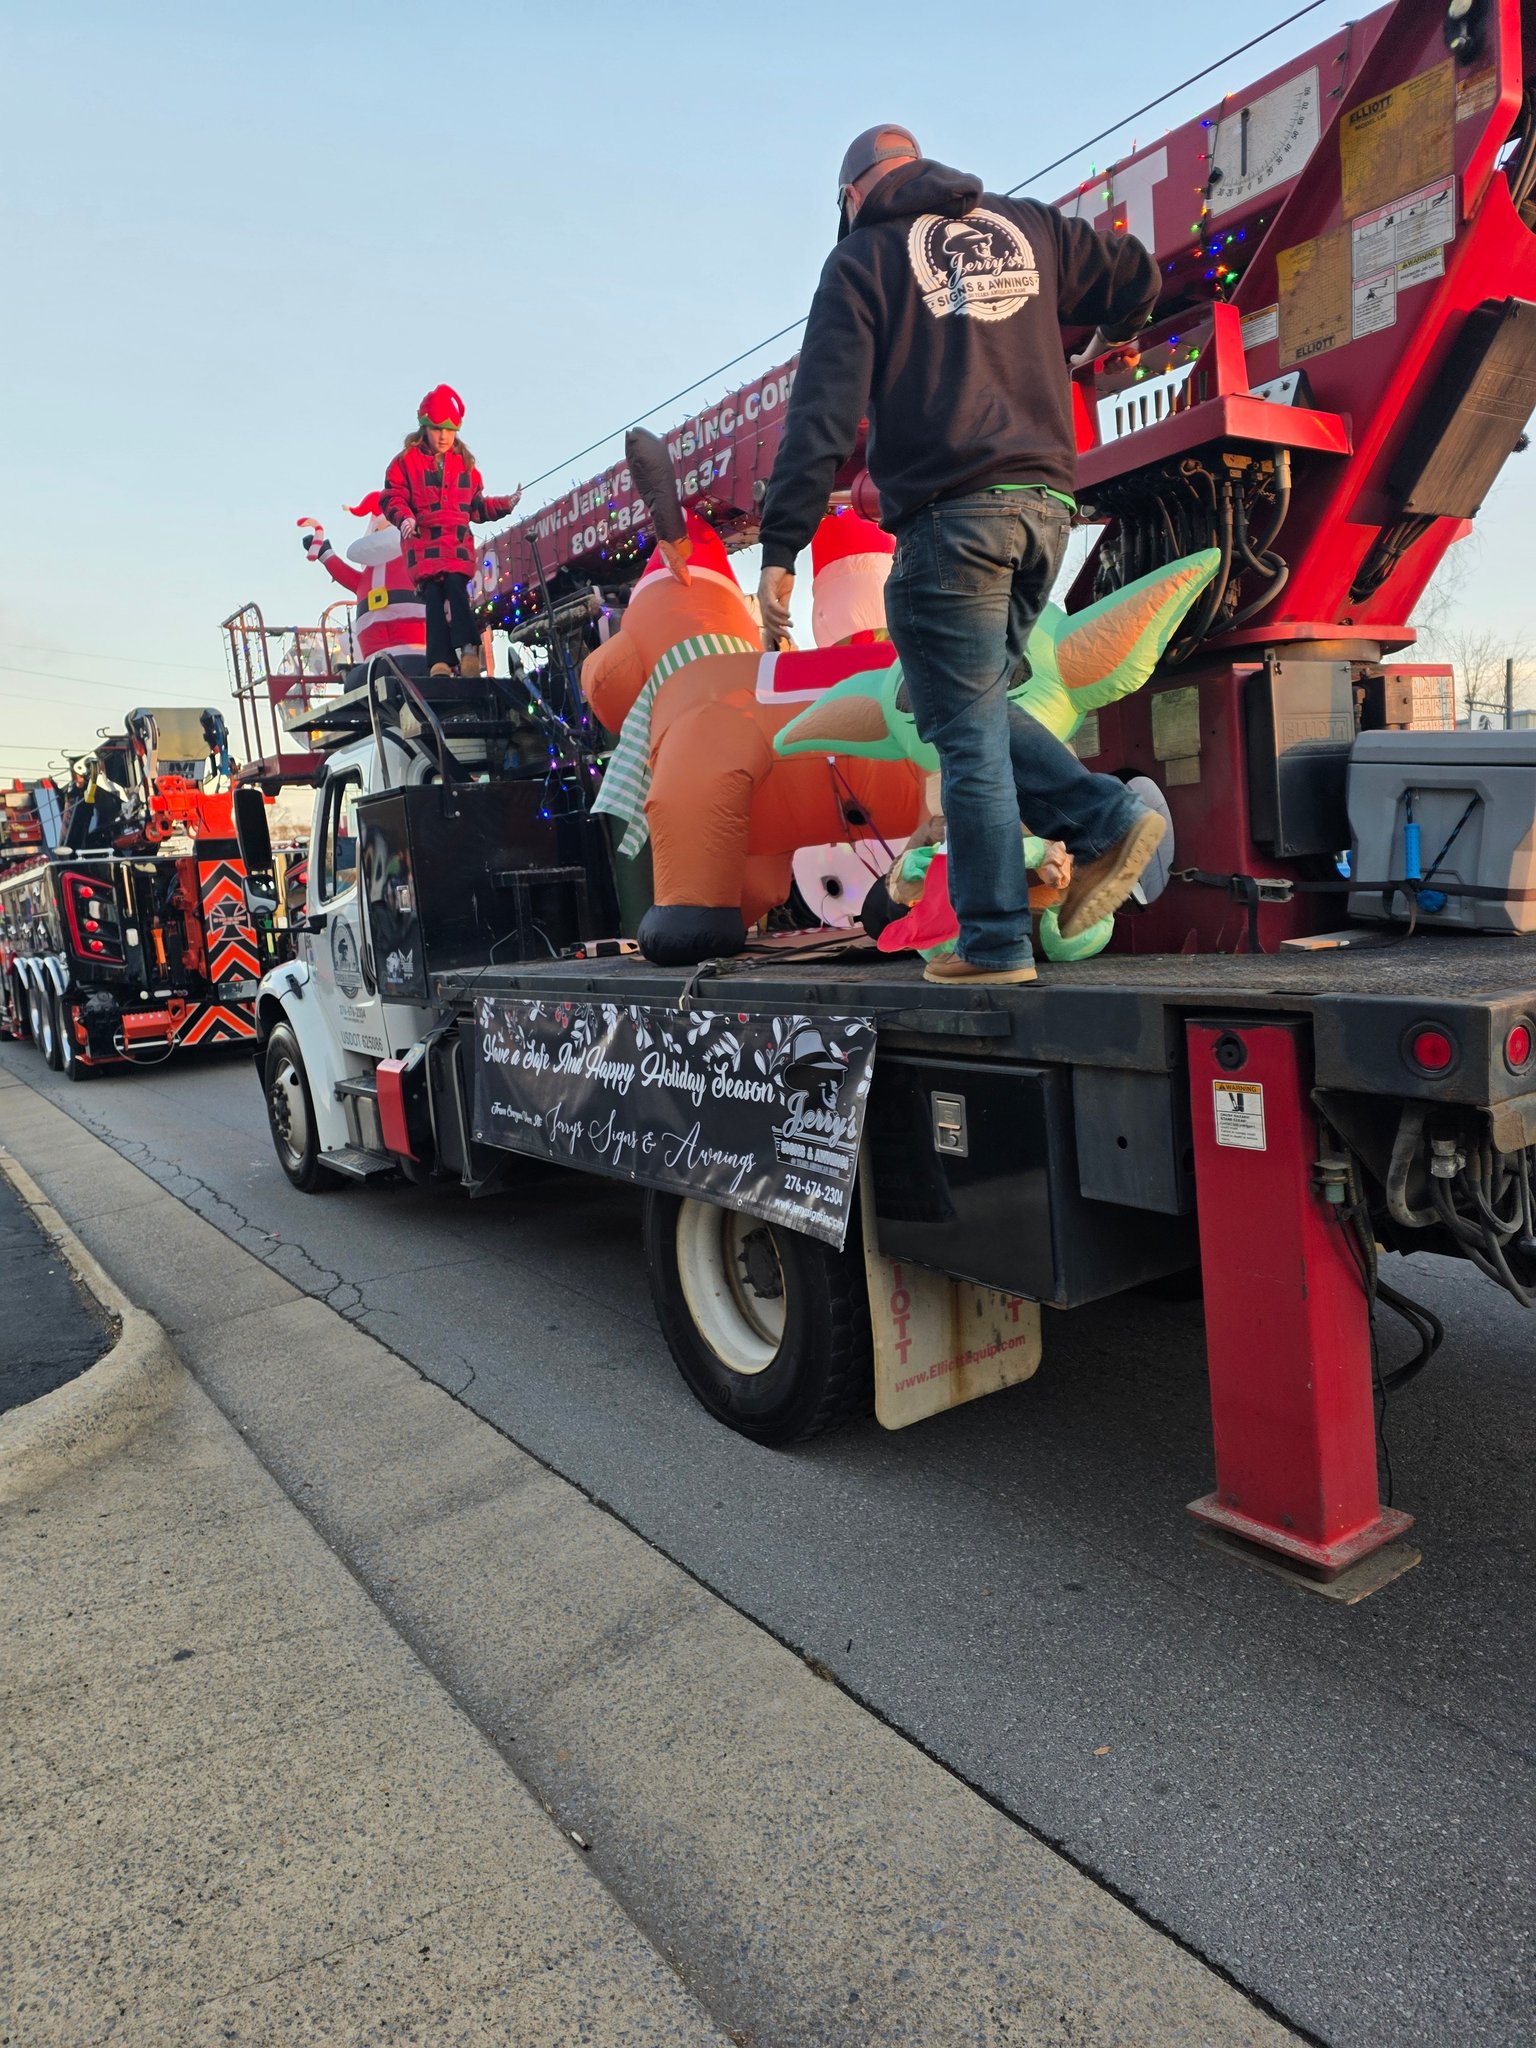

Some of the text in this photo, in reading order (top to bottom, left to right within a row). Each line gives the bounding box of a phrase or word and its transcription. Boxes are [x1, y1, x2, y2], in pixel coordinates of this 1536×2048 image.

[1349, 94, 1393, 124] ELLIOTT
[1284, 143, 1292, 153] 40
[948, 250, 1015, 289] Jerry's
[1407, 249, 1438, 267] WARNING
[937, 276, 1035, 307] SIGNS & AWNINGS
[1296, 335, 1335, 359] ELLIOTT
[483, 1033, 775, 1107] Have a Safe And Happy Holiday Season
[1227, 1085, 1257, 1093] WARNING
[782, 1091, 857, 1148] Jerry's
[588, 1109, 638, 1165] Signs
[642, 1131, 656, 1154] &
[662, 1121, 757, 1194] Awnings
[784, 1174, 843, 1207] 276-676-2304
